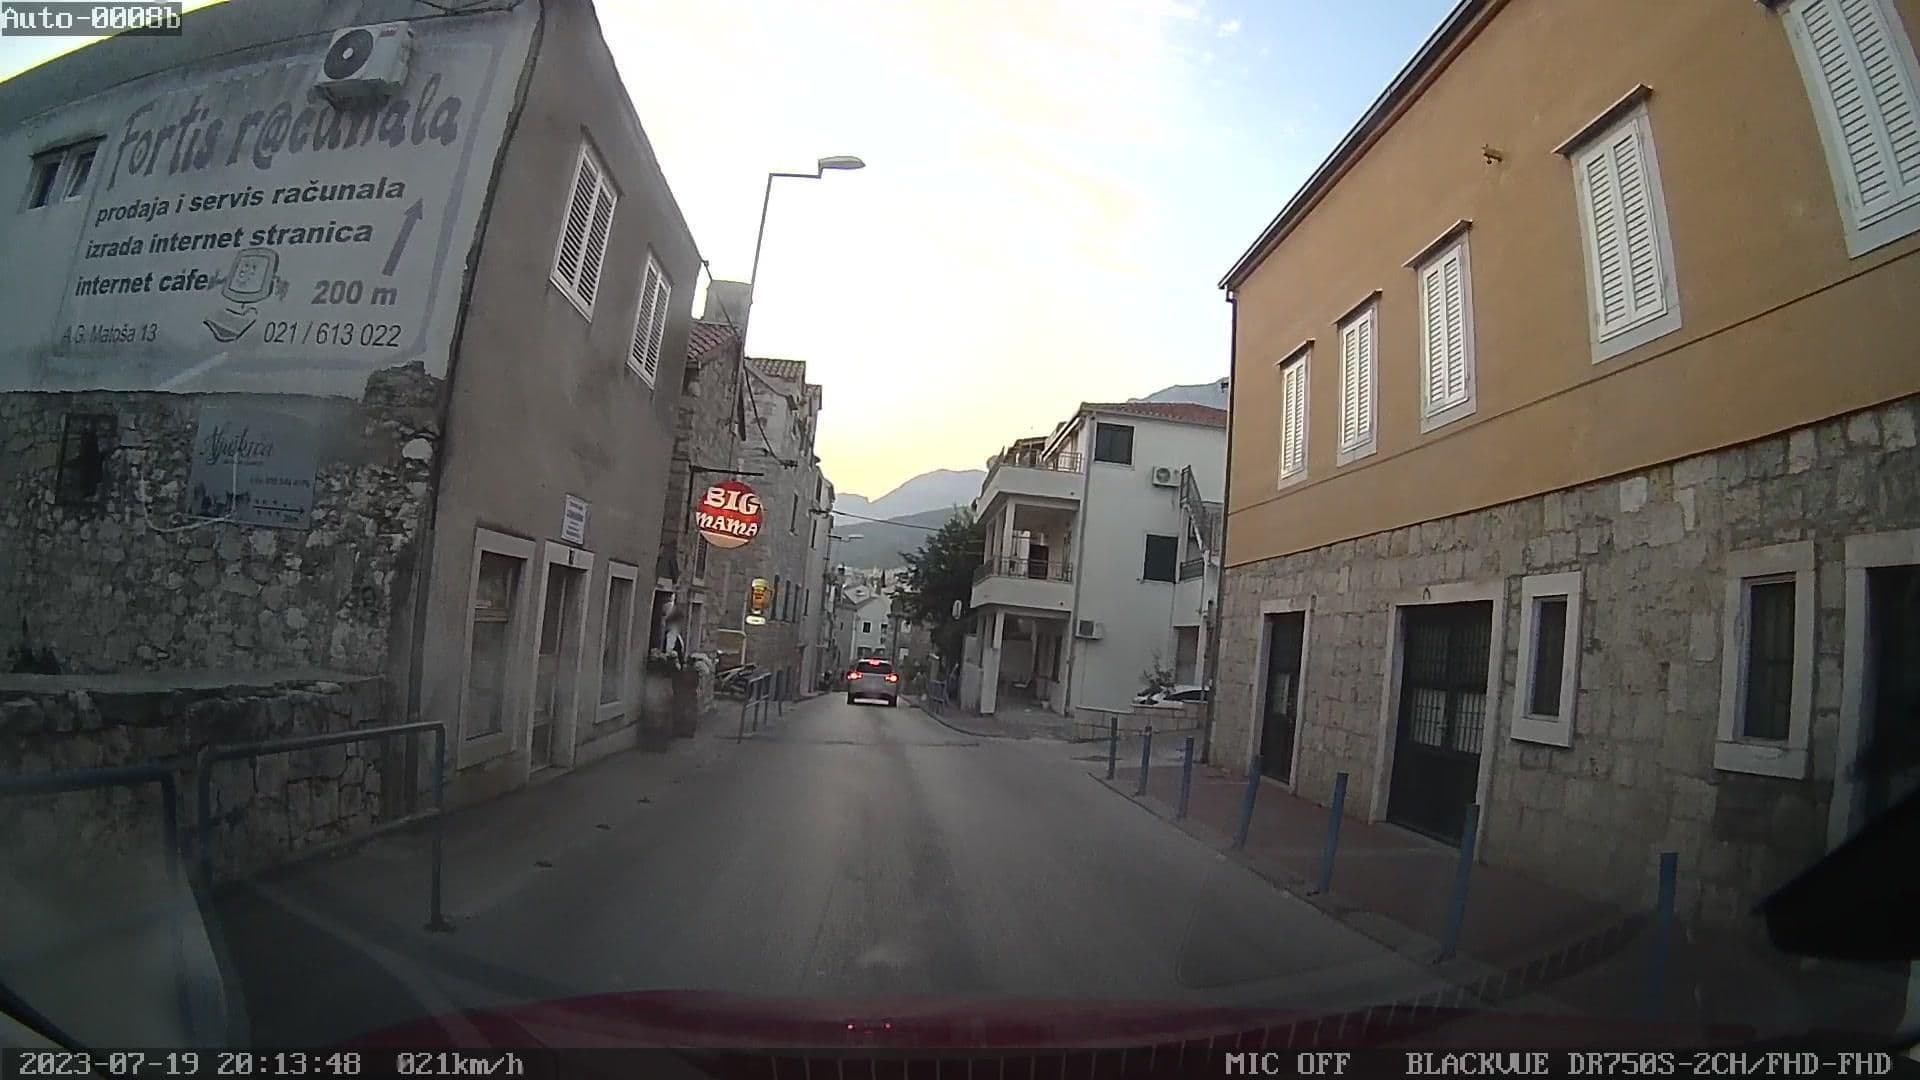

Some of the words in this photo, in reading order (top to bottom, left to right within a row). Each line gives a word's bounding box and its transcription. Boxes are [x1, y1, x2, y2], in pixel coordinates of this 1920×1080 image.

[106, 96, 224, 191] Fortis
[95, 197, 168, 227] prodaja
[175, 194, 185, 213] i
[188, 186, 264, 212] servis
[271, 177, 406, 205] računala
[85, 236, 144, 260] izrada
[149, 226, 244, 254] internet
[250, 221, 374, 246] stranica
[75, 272, 154, 297] internet
[311, 280, 364, 305] 200
[371, 287, 398, 306] m
[141, 322, 158, 342] 13
[263, 321, 298, 344] 021
[316, 322, 354, 346] 613
[360, 323, 402, 348] 022
[703, 486, 762, 516] BIG
[695, 511, 758, 537] MAMA
